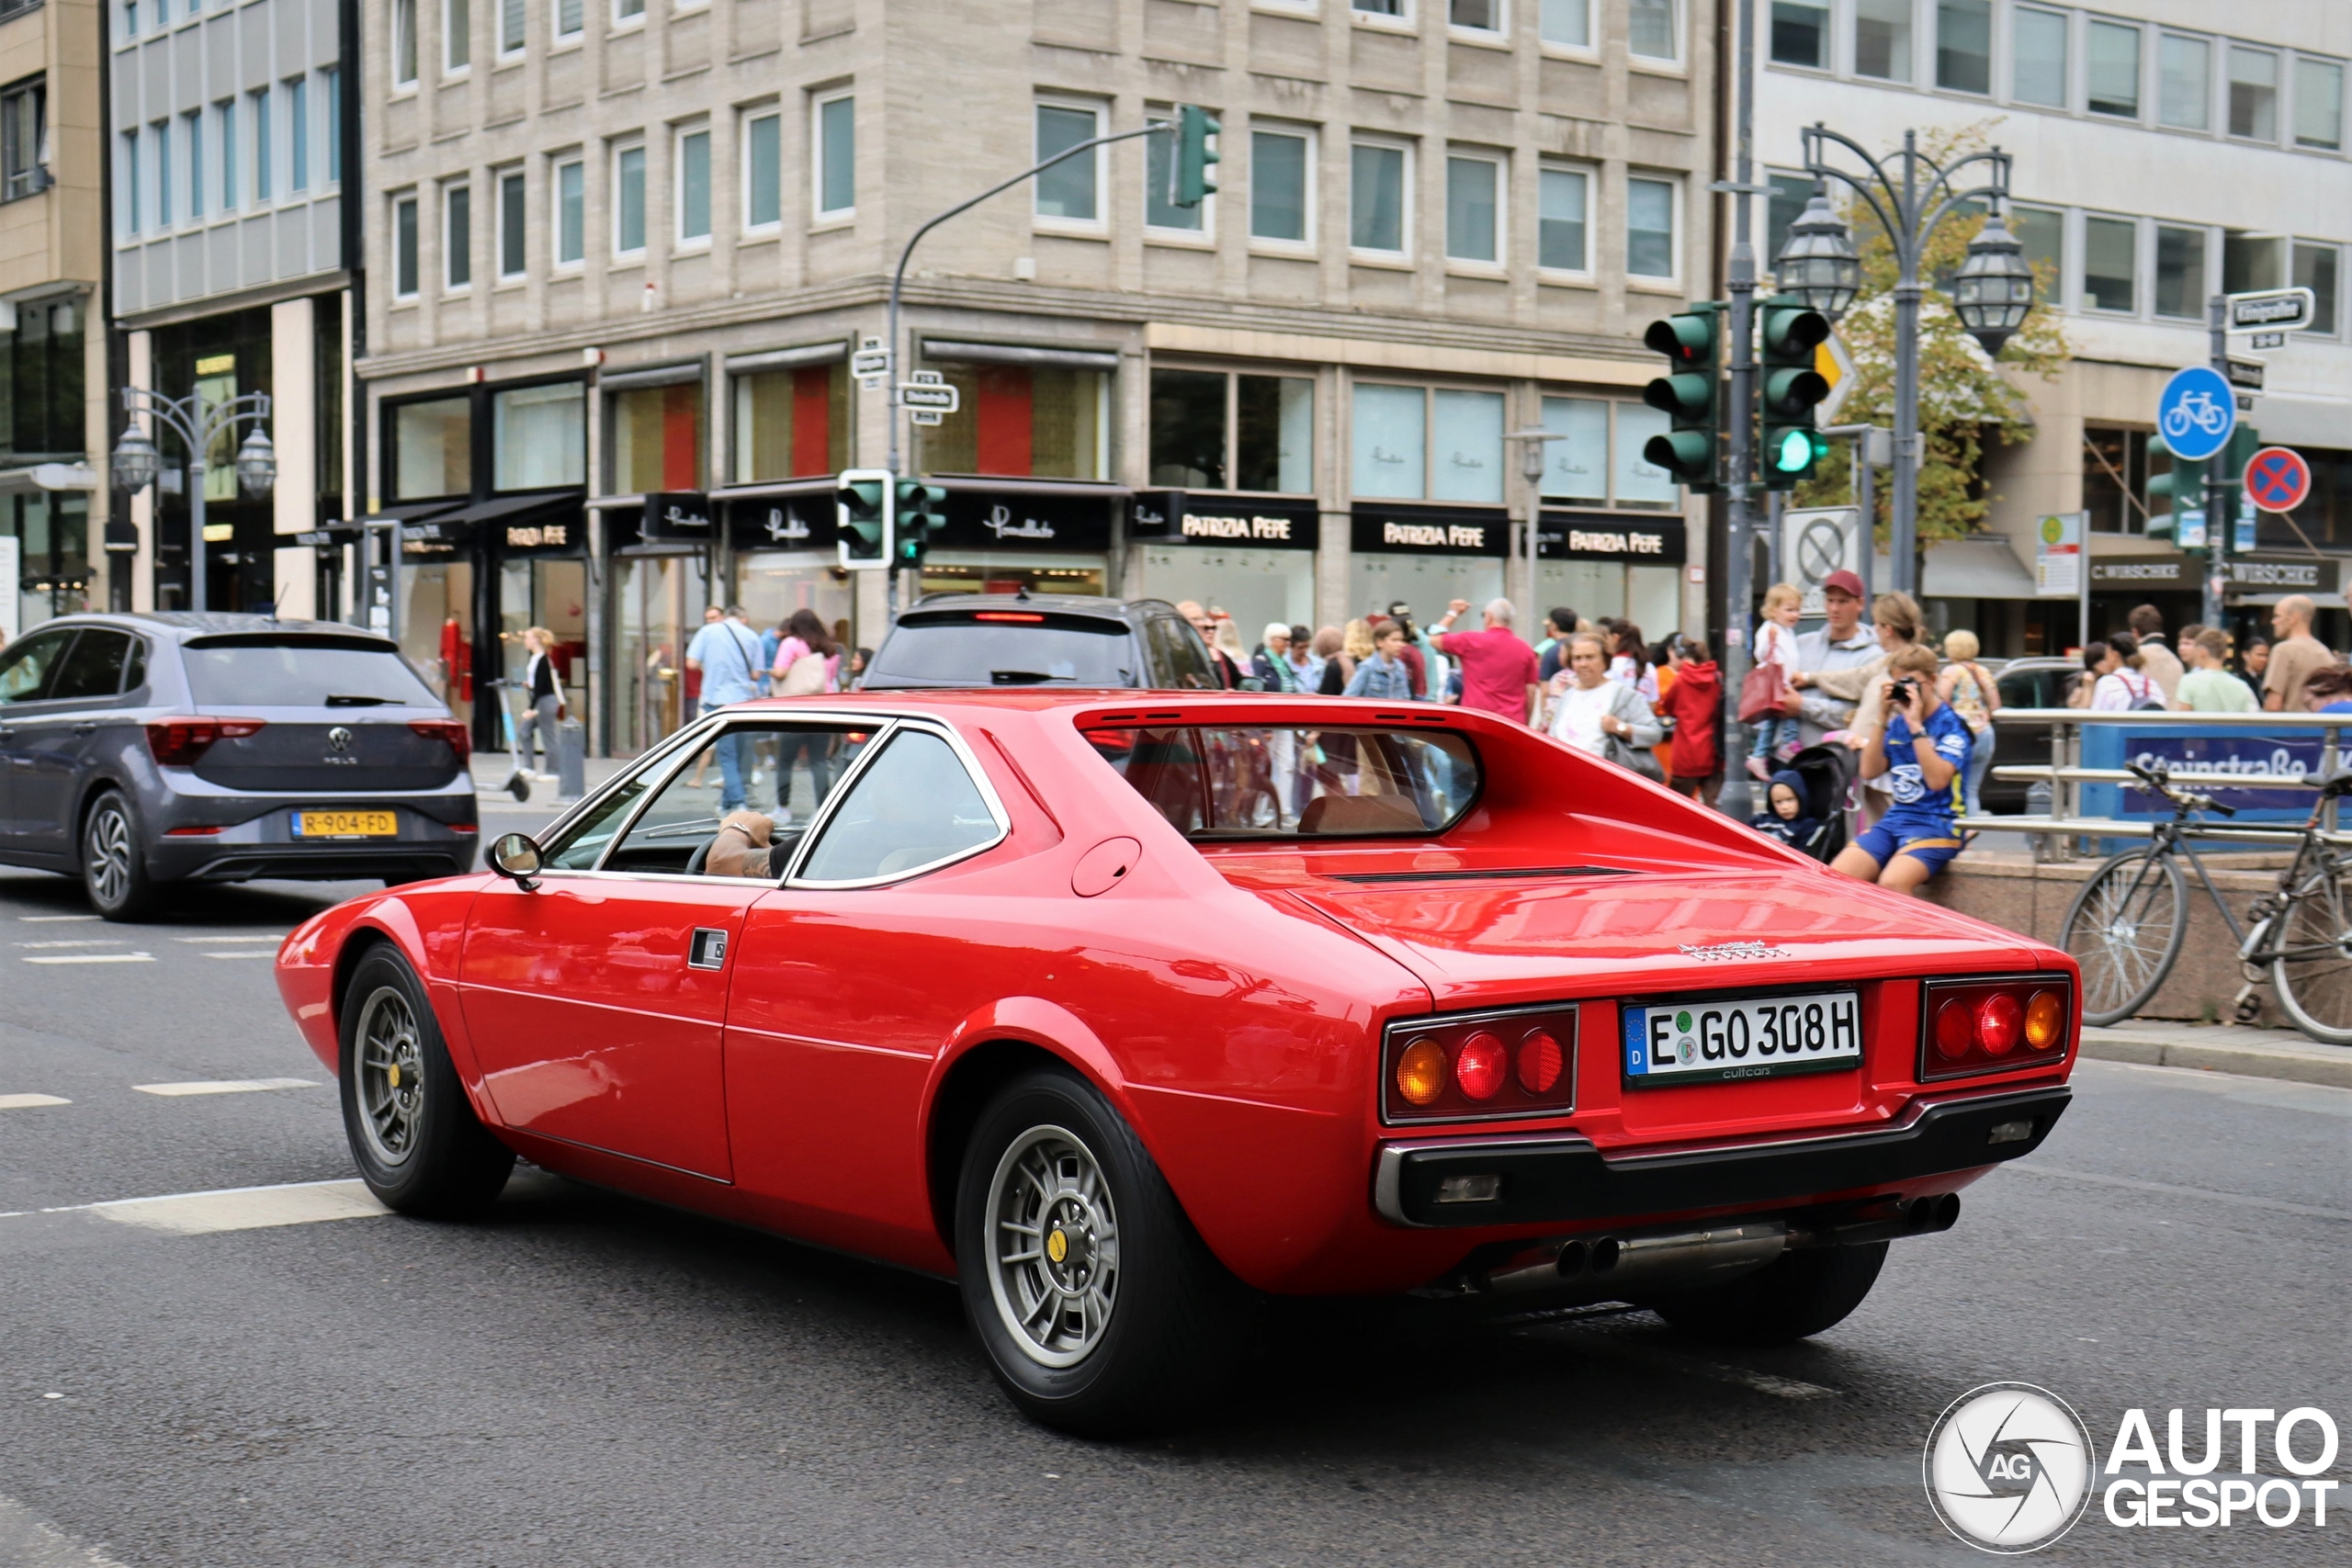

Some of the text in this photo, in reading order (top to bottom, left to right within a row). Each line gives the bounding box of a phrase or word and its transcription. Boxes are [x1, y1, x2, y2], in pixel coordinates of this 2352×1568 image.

[1182, 513, 1250, 538] PATRIZIA
[1252, 515, 1292, 540] PEPE
[1384, 522, 1485, 547] PATRIZIA PEPE
[1569, 530, 1628, 552] PATRIZIA
[1629, 533, 1663, 554] PEPE
[305, 814, 389, 832] R-904-FD
[1651, 1014, 1676, 1066] E
[1632, 1050, 1642, 1066] D
[1723, 1066, 1771, 1079] cultcars
